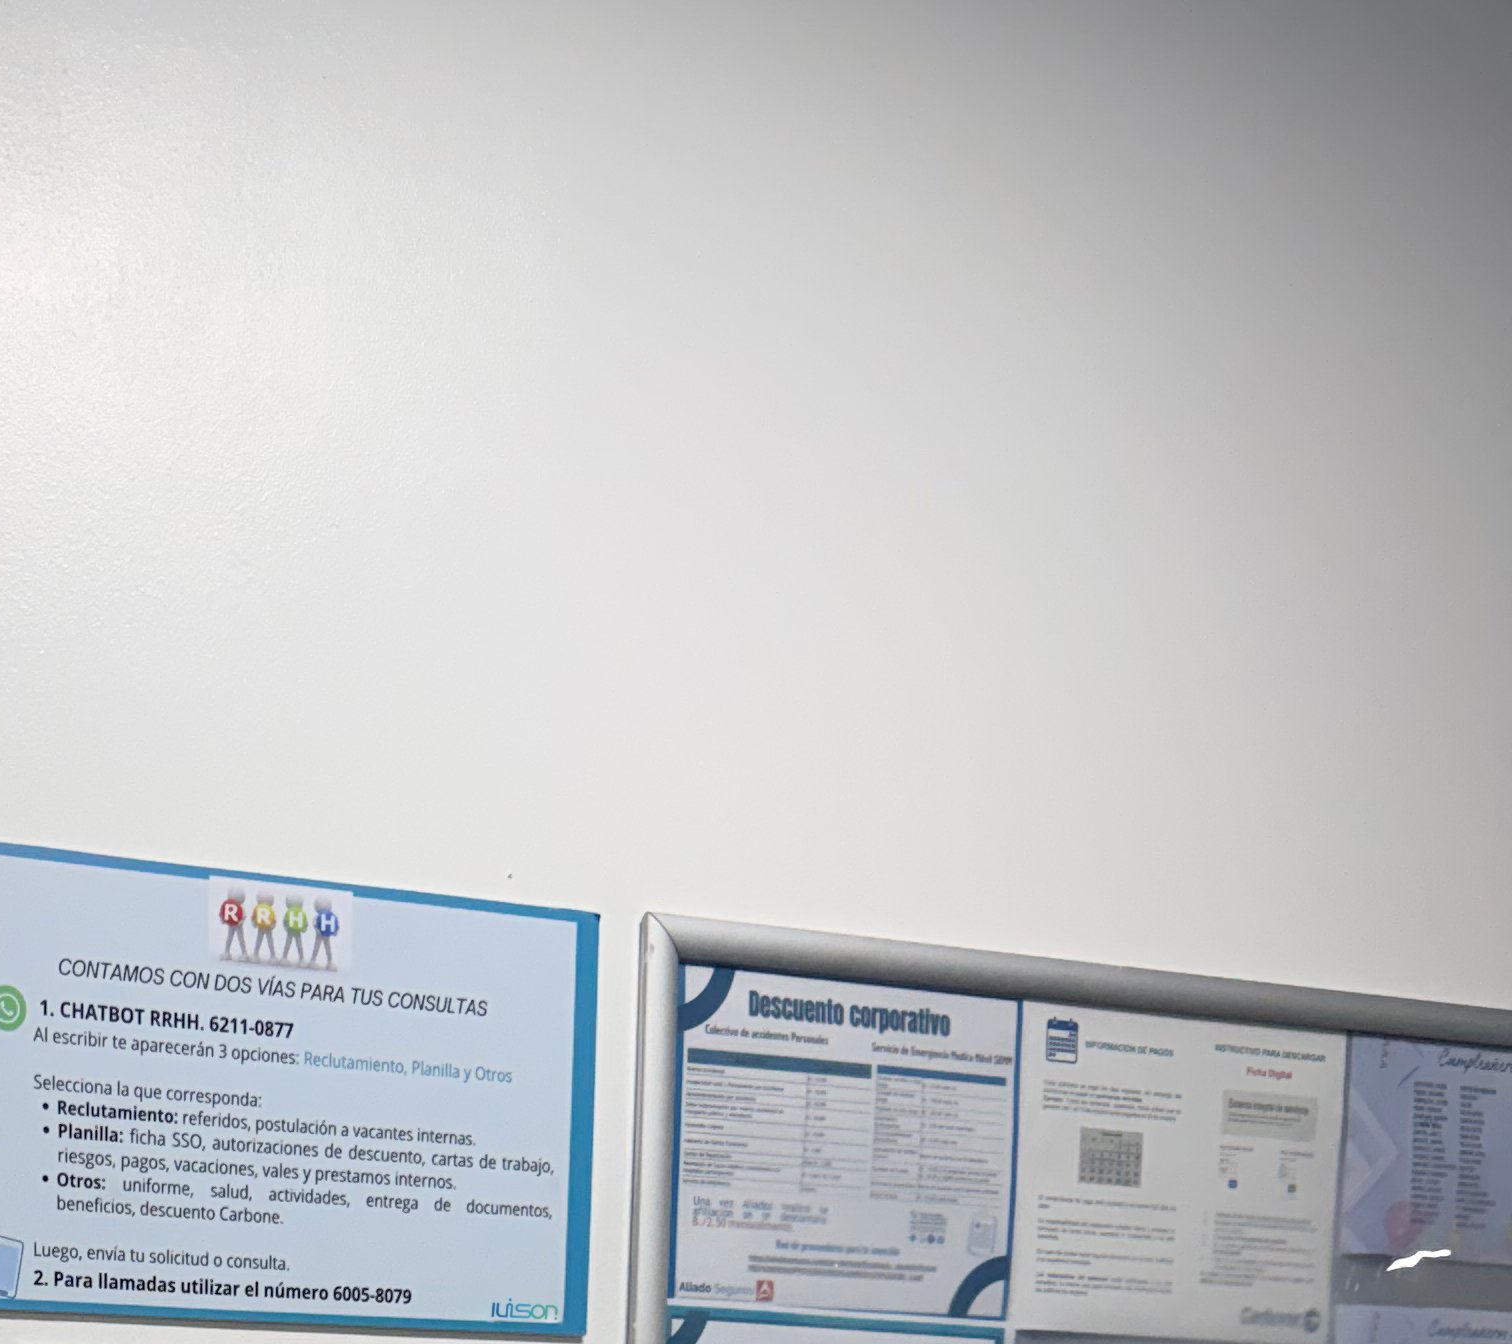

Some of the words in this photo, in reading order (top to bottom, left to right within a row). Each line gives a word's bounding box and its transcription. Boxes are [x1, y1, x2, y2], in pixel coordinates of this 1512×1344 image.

[59, 958, 165, 985] CONTAMOS
[170, 969, 210, 990] CON
[214, 974, 252, 994] DOS
[258, 976, 296, 999] VÍAS
[300, 983, 345, 1003] PARA
[351, 987, 383, 1007] TUS
[388, 991, 488, 1016] CONSULTAS
[40, 1000, 54, 1017] 1.
[60, 1002, 145, 1025] CHATBOT
[150, 1012, 205, 1031] RRHH.
[209, 1016, 294, 1039] 6211-0877
[740, 1028, 749, 1038] de
[749, 990, 844, 1026] Descuento
[849, 1004, 951, 1036] corporativo
[33, 1026, 48, 1043] Al
[52, 1029, 108, 1048] escribir
[112, 1035, 127, 1050] te
[131, 1038, 214, 1059] aparecerán
[218, 1044, 227, 1058] 3
[231, 1046, 299, 1065] opciones:
[304, 1052, 408, 1076] Reclutamiento,
[411, 1060, 460, 1079] Planilla
[463, 1068, 471, 1084] y
[475, 1066, 513, 1083] Otros
[33, 1074, 112, 1096] Selecciona
[117, 1081, 129, 1097] la
[134, 1085, 162, 1102] que
[166, 1087, 262, 1108] corresponda:
[57, 1100, 178, 1124] Reclutamiento:
[182, 1111, 251, 1132] referidos,
[255, 1117, 337, 1136] postulación
[341, 1125, 349, 1137] a
[353, 1125, 414, 1143] vacantes
[417, 1128, 477, 1146] internas.
[57, 1148, 116, 1170] riesgos,
[121, 1155, 170, 1173] pagos,
[174, 1156, 258, 1179] vacaciones,
[262, 1162, 299, 1179] vales
[303, 1168, 311, 1184] y
[315, 1167, 391, 1186] prestamos
[395, 1171, 457, 1190] internos.
[58, 1123, 124, 1143] Planilla:
[129, 1127, 166, 1147] ficha
[172, 1132, 206, 1151] SSO,
[212, 1136, 319, 1158] autorizaciones
[324, 1142, 343, 1158] de
[349, 1145, 426, 1166] descuento,
[431, 1152, 474, 1169] cartas
[479, 1154, 496, 1170] de
[502, 1157, 555, 1177] trabajo,
[56, 1195, 136, 1217] beneficios,
[140, 1201, 215, 1220] descuento
[219, 1207, 284, 1225] Carbone.
[57, 1172, 106, 1190] Otros:
[122, 1177, 194, 1198] uniforme,
[210, 1183, 253, 1202] salud,
[268, 1188, 351, 1208] actividades,
[366, 1193, 419, 1214] entrega
[434, 1196, 451, 1212] de
[466, 1199, 553, 1220] documentos,
[33, 1241, 83, 1263] Luego,
[87, 1245, 126, 1263] envía
[130, 1248, 145, 1262] tu
[149, 1249, 209, 1267] solicitud
[213, 1255, 222, 1267] o
[226, 1254, 290, 1272] consulta.
[33, 1270, 48, 1287] 2.
[54, 1271, 93, 1289] Para
[98, 1272, 176, 1293] llamadas
[181, 1278, 240, 1297] utilizar
[244, 1281, 259, 1297] el
[264, 1283, 329, 1300] número
[333, 1286, 412, 1304] 6005-8079
